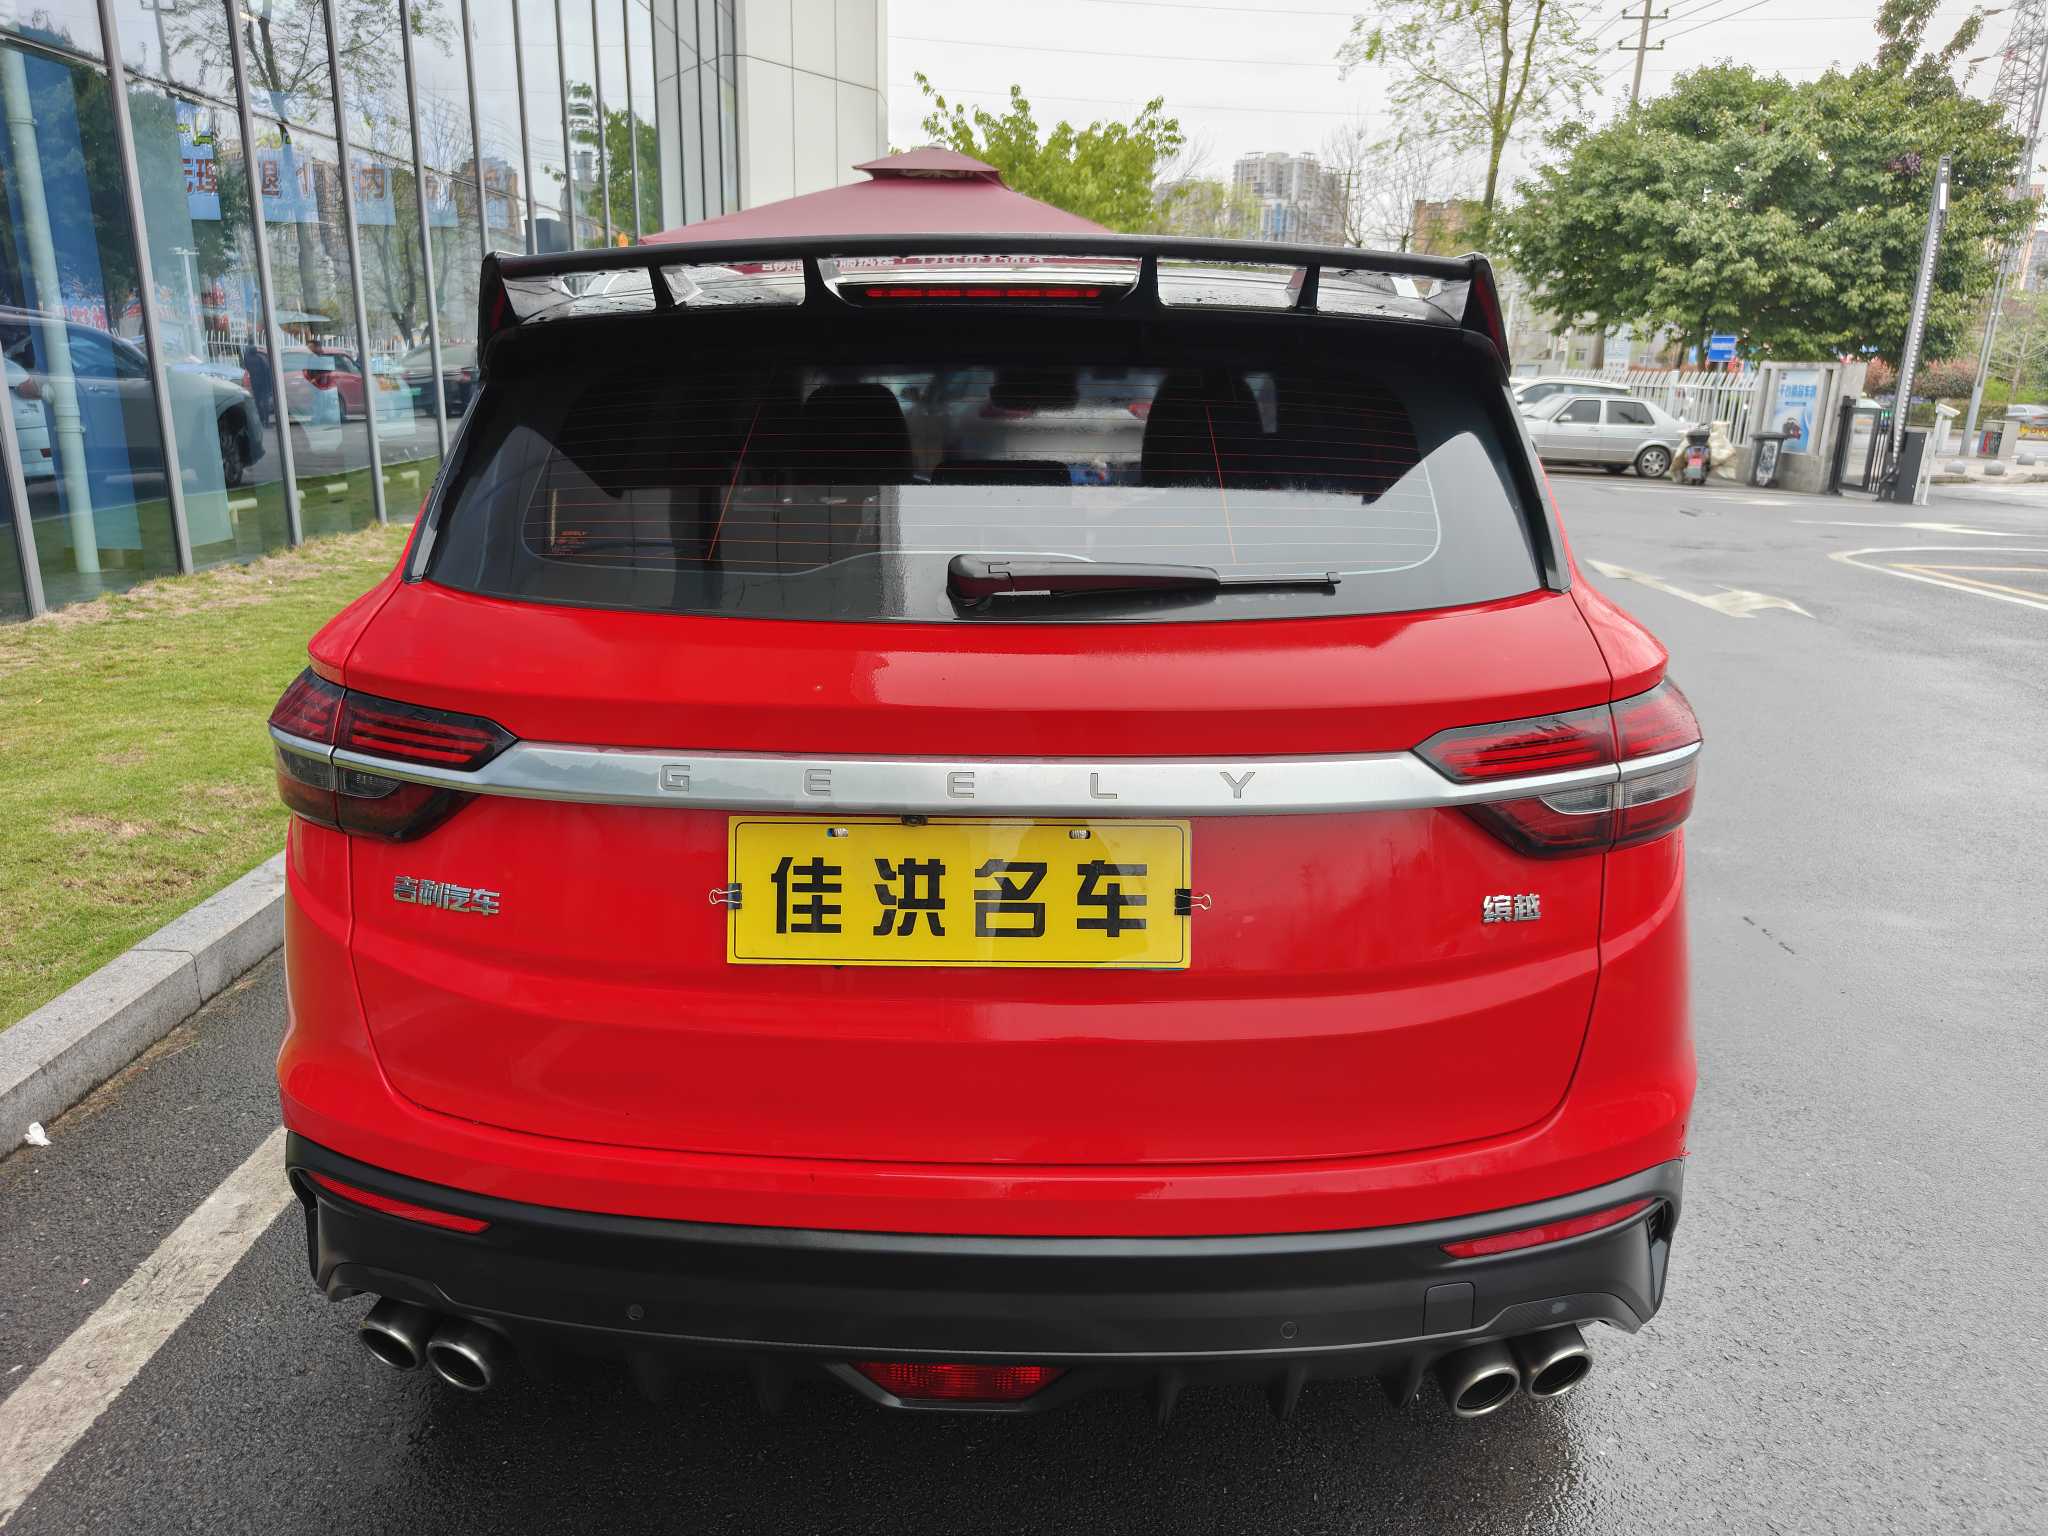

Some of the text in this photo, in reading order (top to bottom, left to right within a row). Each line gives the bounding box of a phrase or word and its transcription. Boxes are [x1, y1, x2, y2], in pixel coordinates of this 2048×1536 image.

[659, 763, 1256, 800] GEELY
[393, 875, 500, 917] 吉利汽车
[770, 856, 1148, 938] 佳洪名车
[1482, 892, 1541, 923] 缤越
